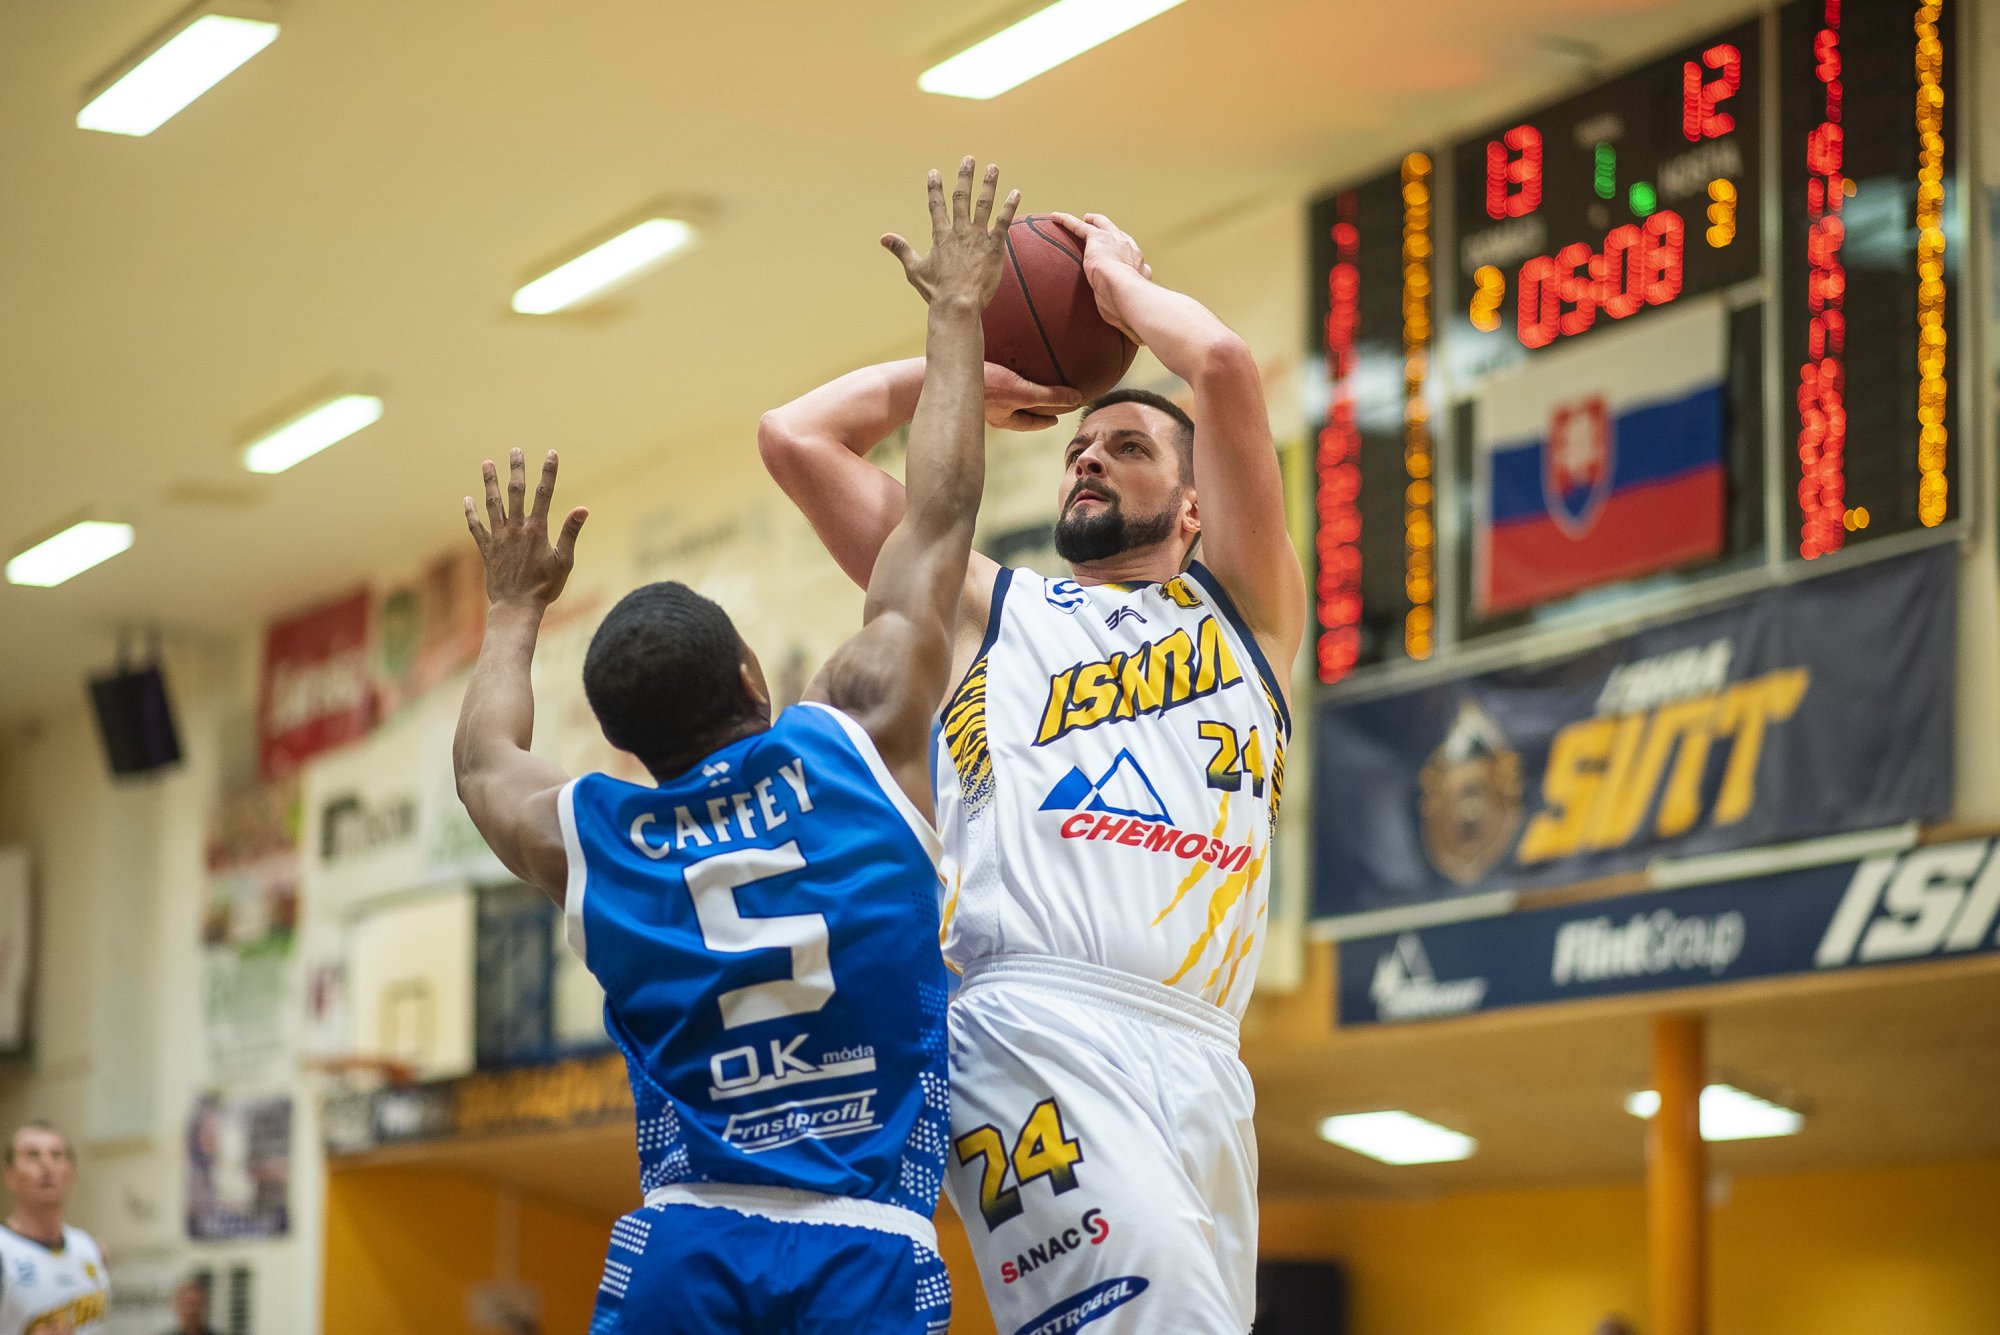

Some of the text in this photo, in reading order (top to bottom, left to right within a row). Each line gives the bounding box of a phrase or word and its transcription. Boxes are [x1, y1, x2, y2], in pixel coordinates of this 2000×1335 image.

[1683, 44, 1741, 141] 12
[1487, 124, 1542, 219] 13
[1031, 614, 1244, 746] ISKRA
[630, 757, 814, 860] CAFFEY
[1515, 665, 1811, 866] SVIT
[682, 839, 837, 1030] 5
[954, 1096, 1085, 1234] 24
[1001, 1228, 1081, 1284] SANAC
